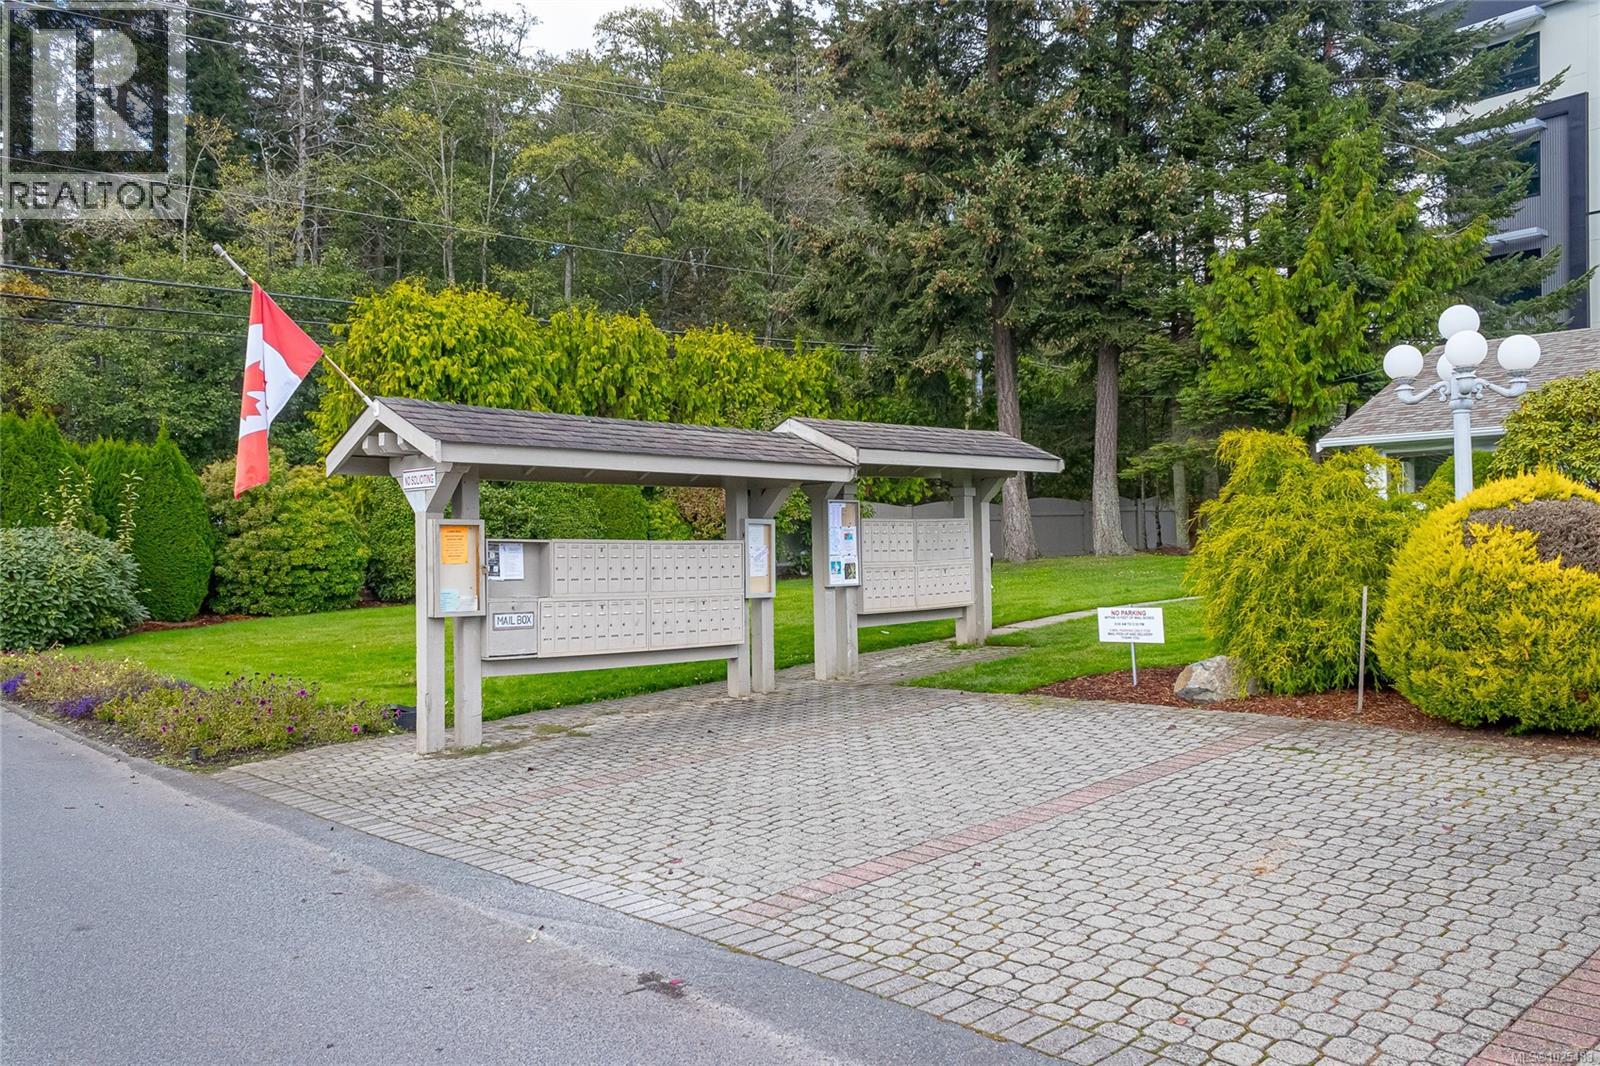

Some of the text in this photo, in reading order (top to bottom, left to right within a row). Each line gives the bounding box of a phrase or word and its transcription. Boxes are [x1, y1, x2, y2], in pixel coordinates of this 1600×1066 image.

[405, 473, 434, 485] NO SOLICITING
[496, 615, 532, 625] MAIL BOX
